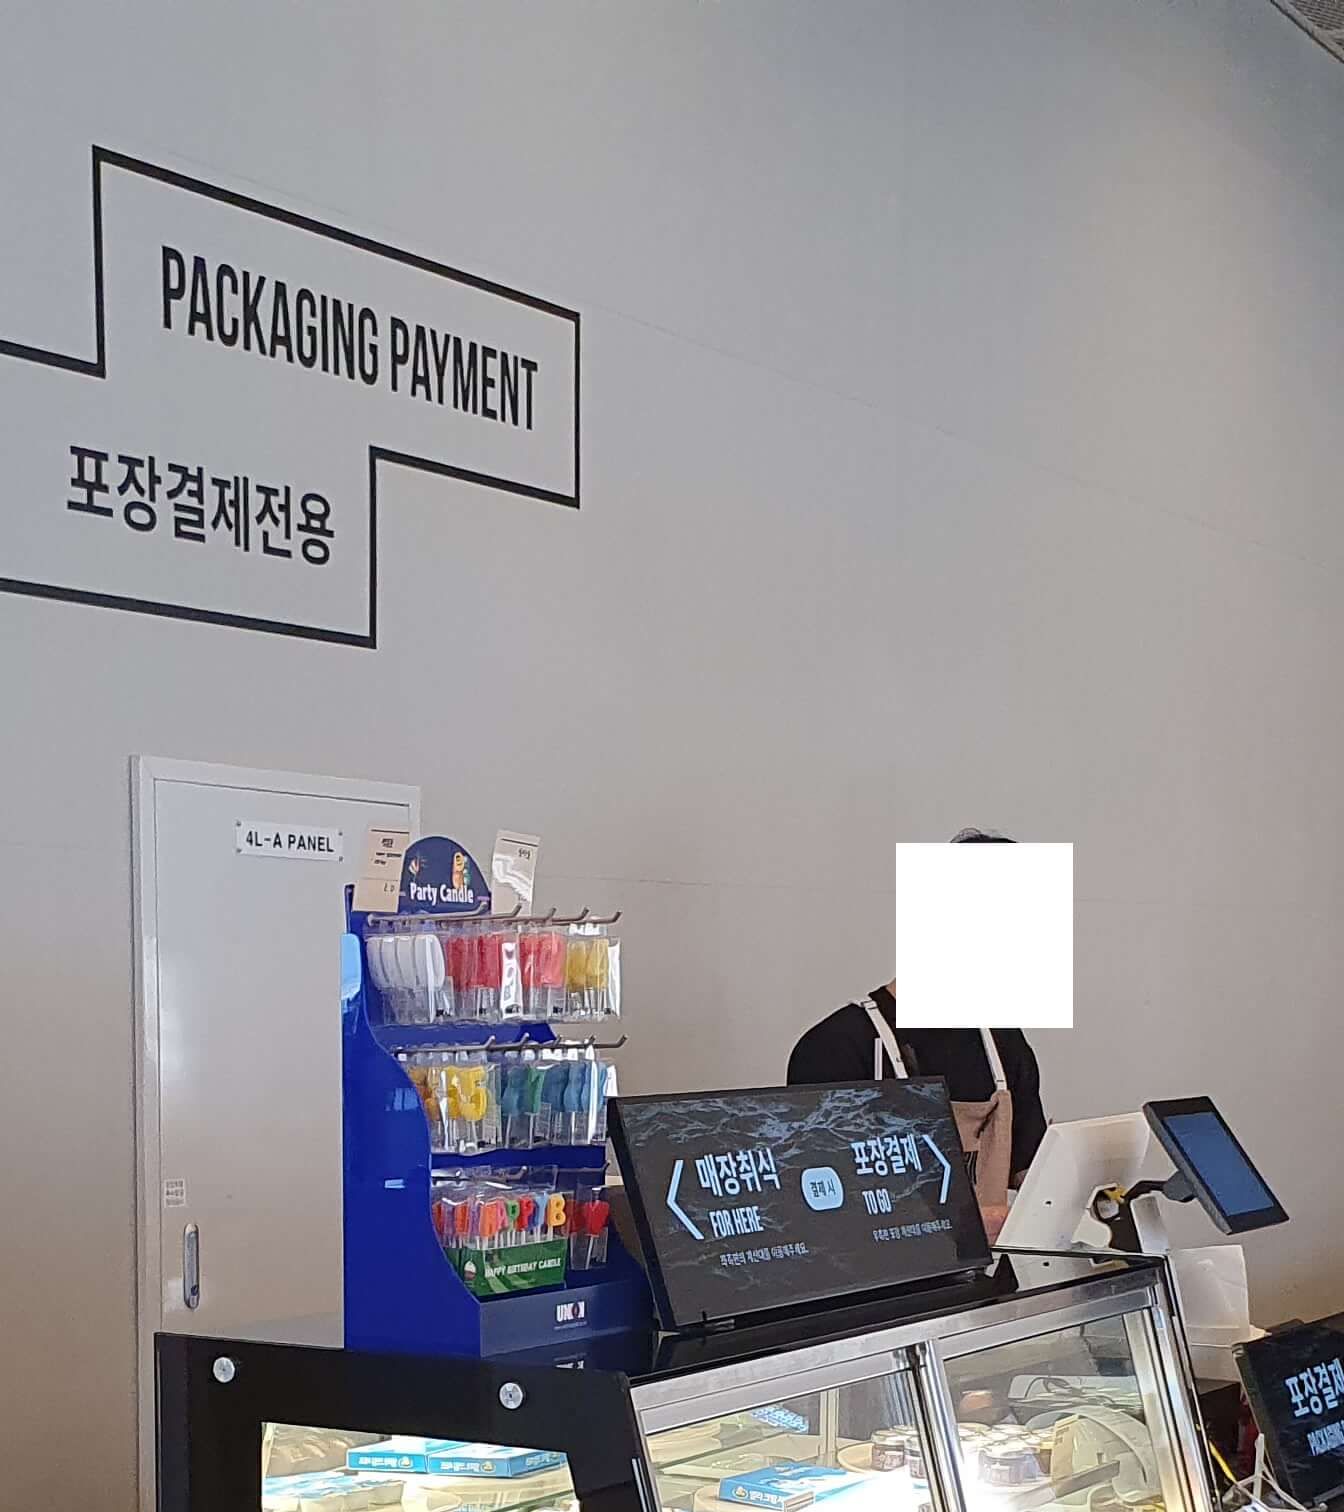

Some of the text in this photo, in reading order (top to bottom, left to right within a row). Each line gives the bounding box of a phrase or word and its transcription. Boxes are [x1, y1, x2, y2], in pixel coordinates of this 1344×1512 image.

[162, 246, 538, 430] PACKAGING PAYMENT
[67, 445, 335, 566] 포장결제전용
[246, 830, 335, 853] 4L-A PANEL
[410, 882, 438, 906] Party
[439, 884, 474, 904] Candle
[695, 1147, 781, 1197] 매장취식
[850, 1133, 923, 1177] 포장결제
[862, 1188, 892, 1216] TO GO
[709, 1205, 764, 1239] FOR HERE
[483, 1264, 507, 1278] HAPPY
